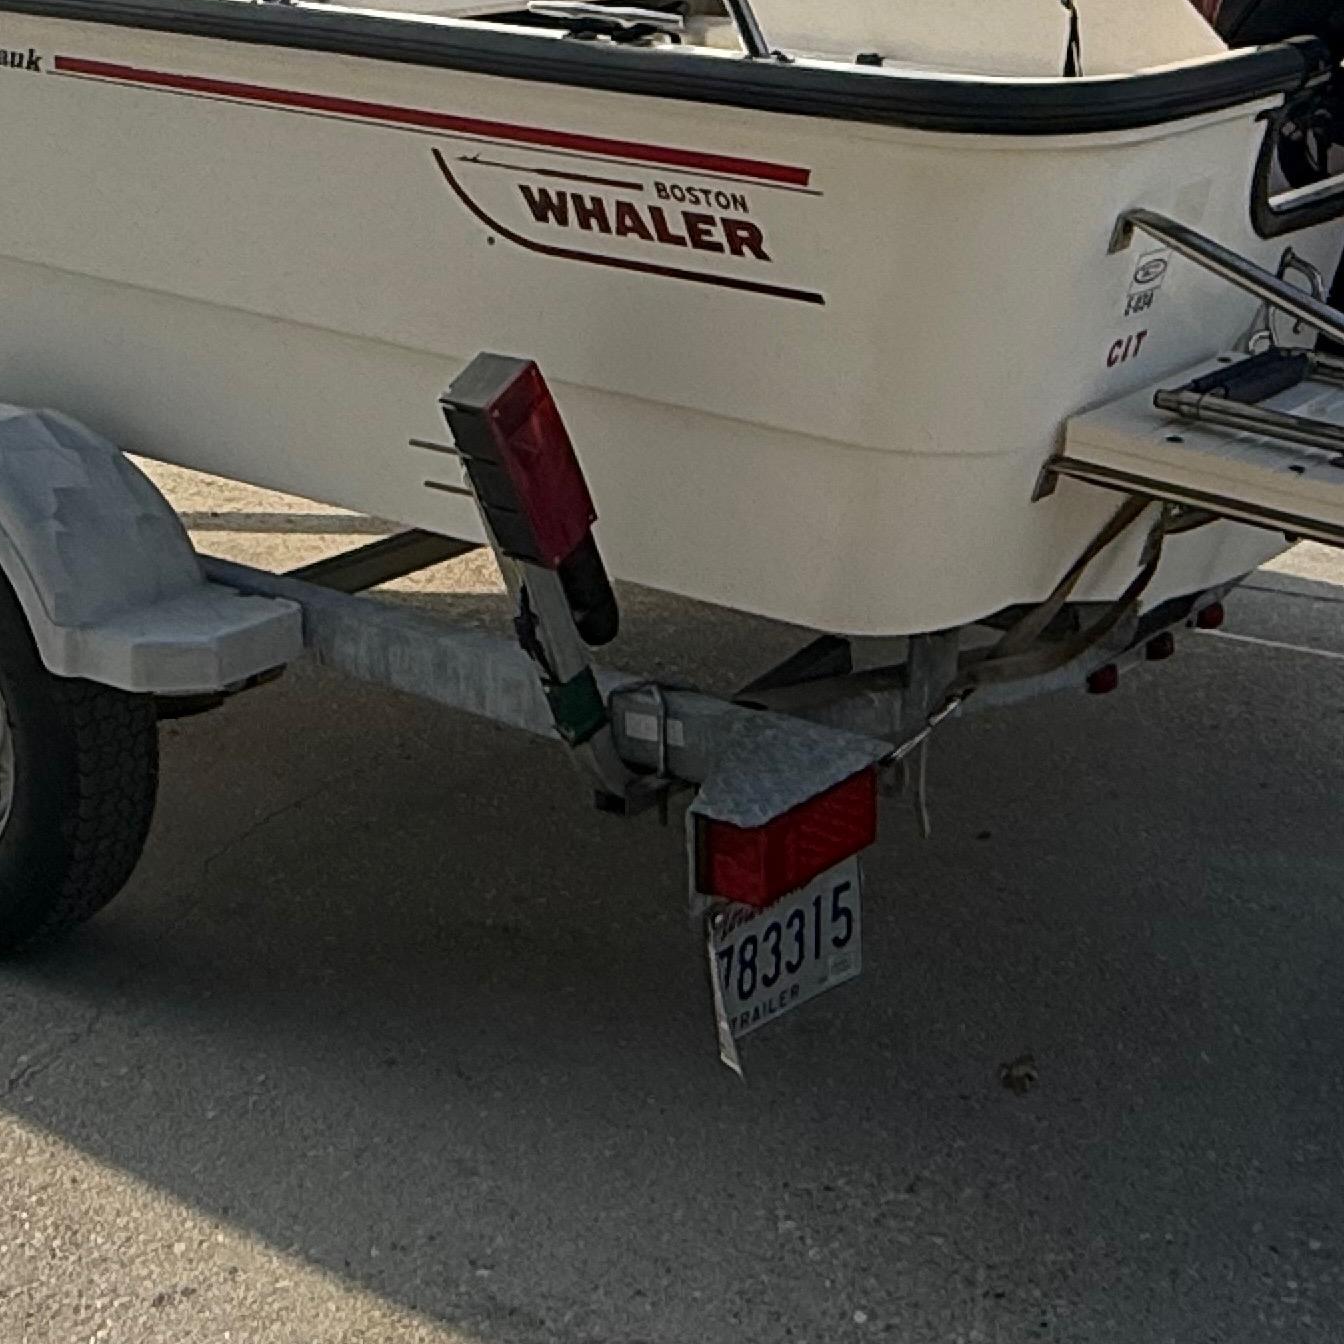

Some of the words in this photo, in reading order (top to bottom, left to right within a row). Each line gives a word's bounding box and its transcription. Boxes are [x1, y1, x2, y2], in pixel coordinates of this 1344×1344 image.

[518, 184, 772, 262] WHALER
[654, 181, 749, 214] BOSTON
[716, 881, 852, 1001] 783315
[728, 982, 800, 1035] TRAILER
